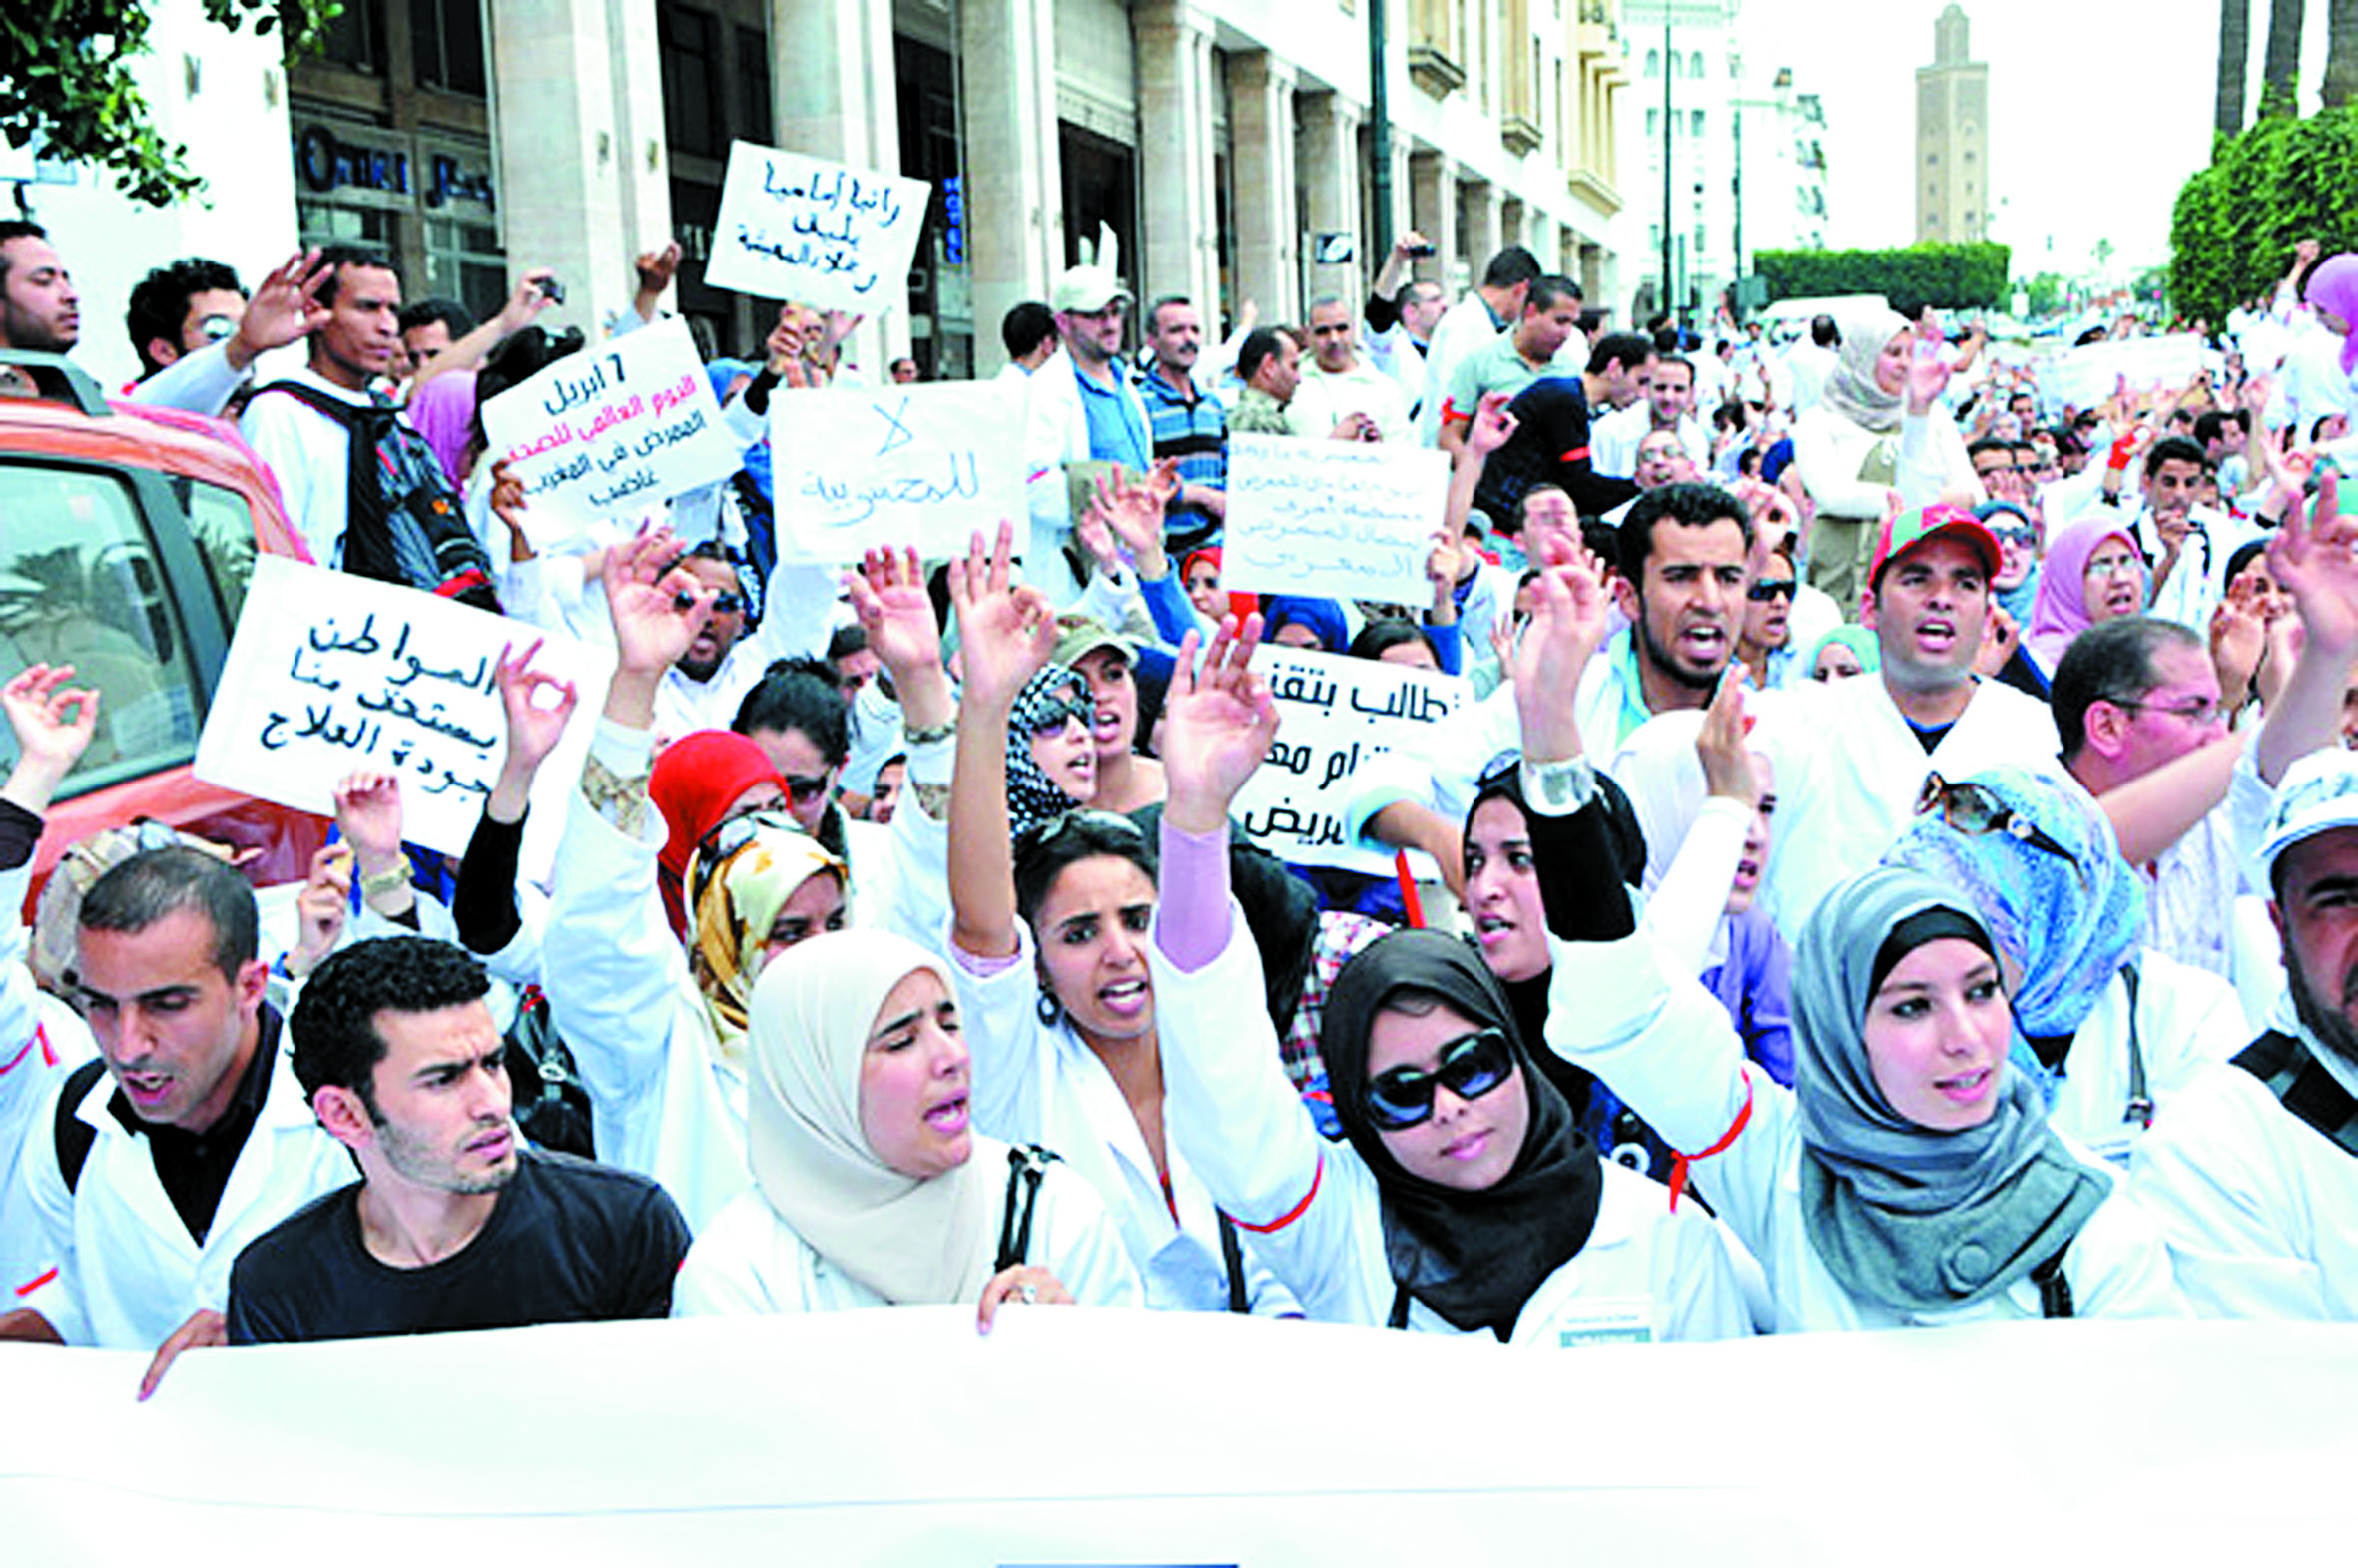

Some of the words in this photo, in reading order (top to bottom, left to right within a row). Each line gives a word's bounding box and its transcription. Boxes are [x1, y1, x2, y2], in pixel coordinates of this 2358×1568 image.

[606, 352, 625, 383] 7
[651, 374, 697, 418] اليوم
[872, 395, 913, 456] لا
[291, 646, 340, 691] منا
[309, 613, 496, 696] المواطن
[1271, 662, 1338, 717] بتقن
[260, 704, 381, 755] العلاج
[357, 687, 497, 760] يستحق
[391, 740, 494, 803] جودة
[1264, 742, 1313, 775] مه
